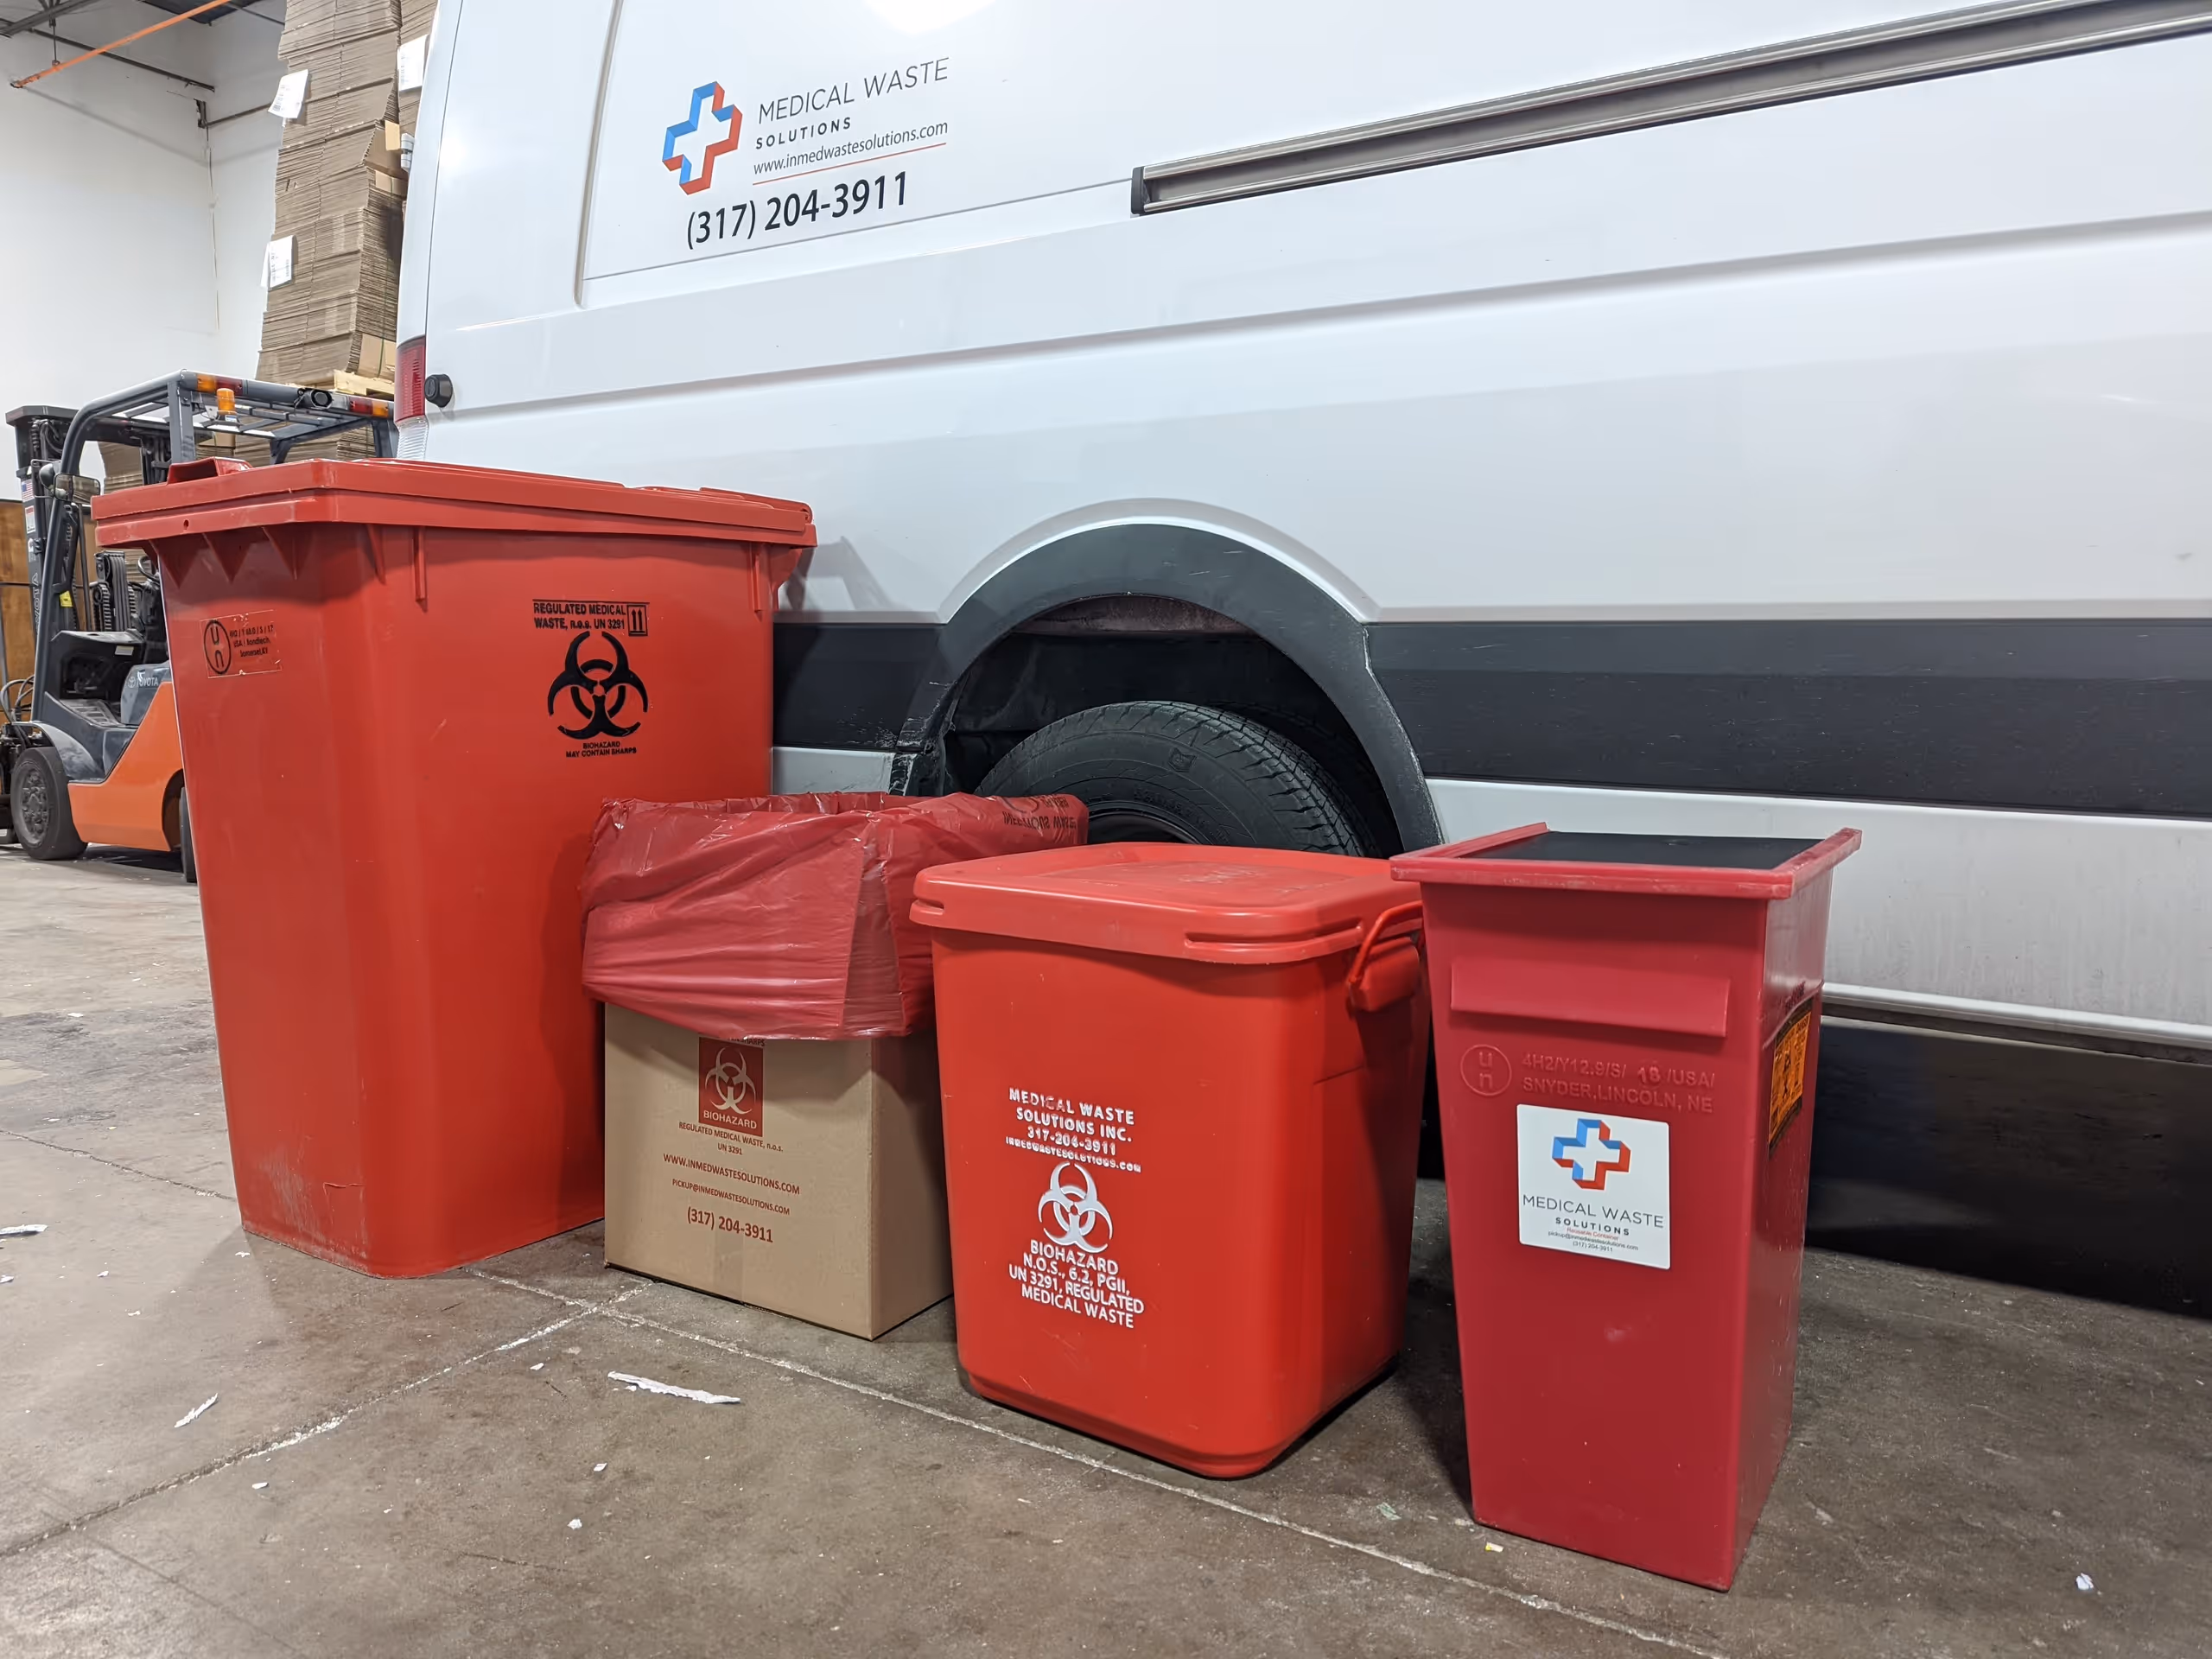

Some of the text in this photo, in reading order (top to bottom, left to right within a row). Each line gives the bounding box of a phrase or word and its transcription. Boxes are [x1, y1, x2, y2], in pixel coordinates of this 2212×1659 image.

[759, 56, 950, 124] MEDICAL WASTE
[753, 121, 948, 175] www.inmedwastesolutions.com
[755, 117, 851, 149] SOLUTIONS
[687, 171, 906, 250] (317) 204-3911
[533, 602, 626, 616] REGULATED MEDICAL
[534, 618, 568, 631] WASTE,
[594, 619, 605, 630] UN
[566, 747, 637, 759] MAY CONTAIN SHARPS
[583, 741, 621, 750] BIOHAZARD
[703, 1109, 757, 1129] BIOHAZARD
[1009, 1087, 1135, 1125] MEDICAL WASTE
[1687, 1095, 1713, 1114] NE
[679, 1122, 784, 1152] REGULATED MEDICAL WASTE, n.o.s.
[1016, 1107, 1132, 1142] SOLUTIONS INC.
[1027, 1126, 1116, 1156] 317-204-3911
[717, 1142, 743, 1155] UN 3291
[663, 1154, 800, 1195] WWW.INMEDWASTESOLUTIONS.COM
[672, 1178, 790, 1216] PICKUP@INMEDWASTESOLUTIONS.COM
[1523, 1194, 1664, 1229] MEDICAL WASTE
[687, 1206, 773, 1243] (317) 204-3911
[1555, 1217, 1630, 1236] SOLUTIONS
[1030, 1239, 1118, 1275] BIOHAZARD
[1573, 1241, 1613, 1253] (317) 204-3911
[1008, 1264, 1145, 1314] UN 3291, REGULATED
[1023, 1253, 1130, 1296] N.O.S., 6.2, PGII,
[1021, 1284, 1134, 1329] MEDICAL WASTE
